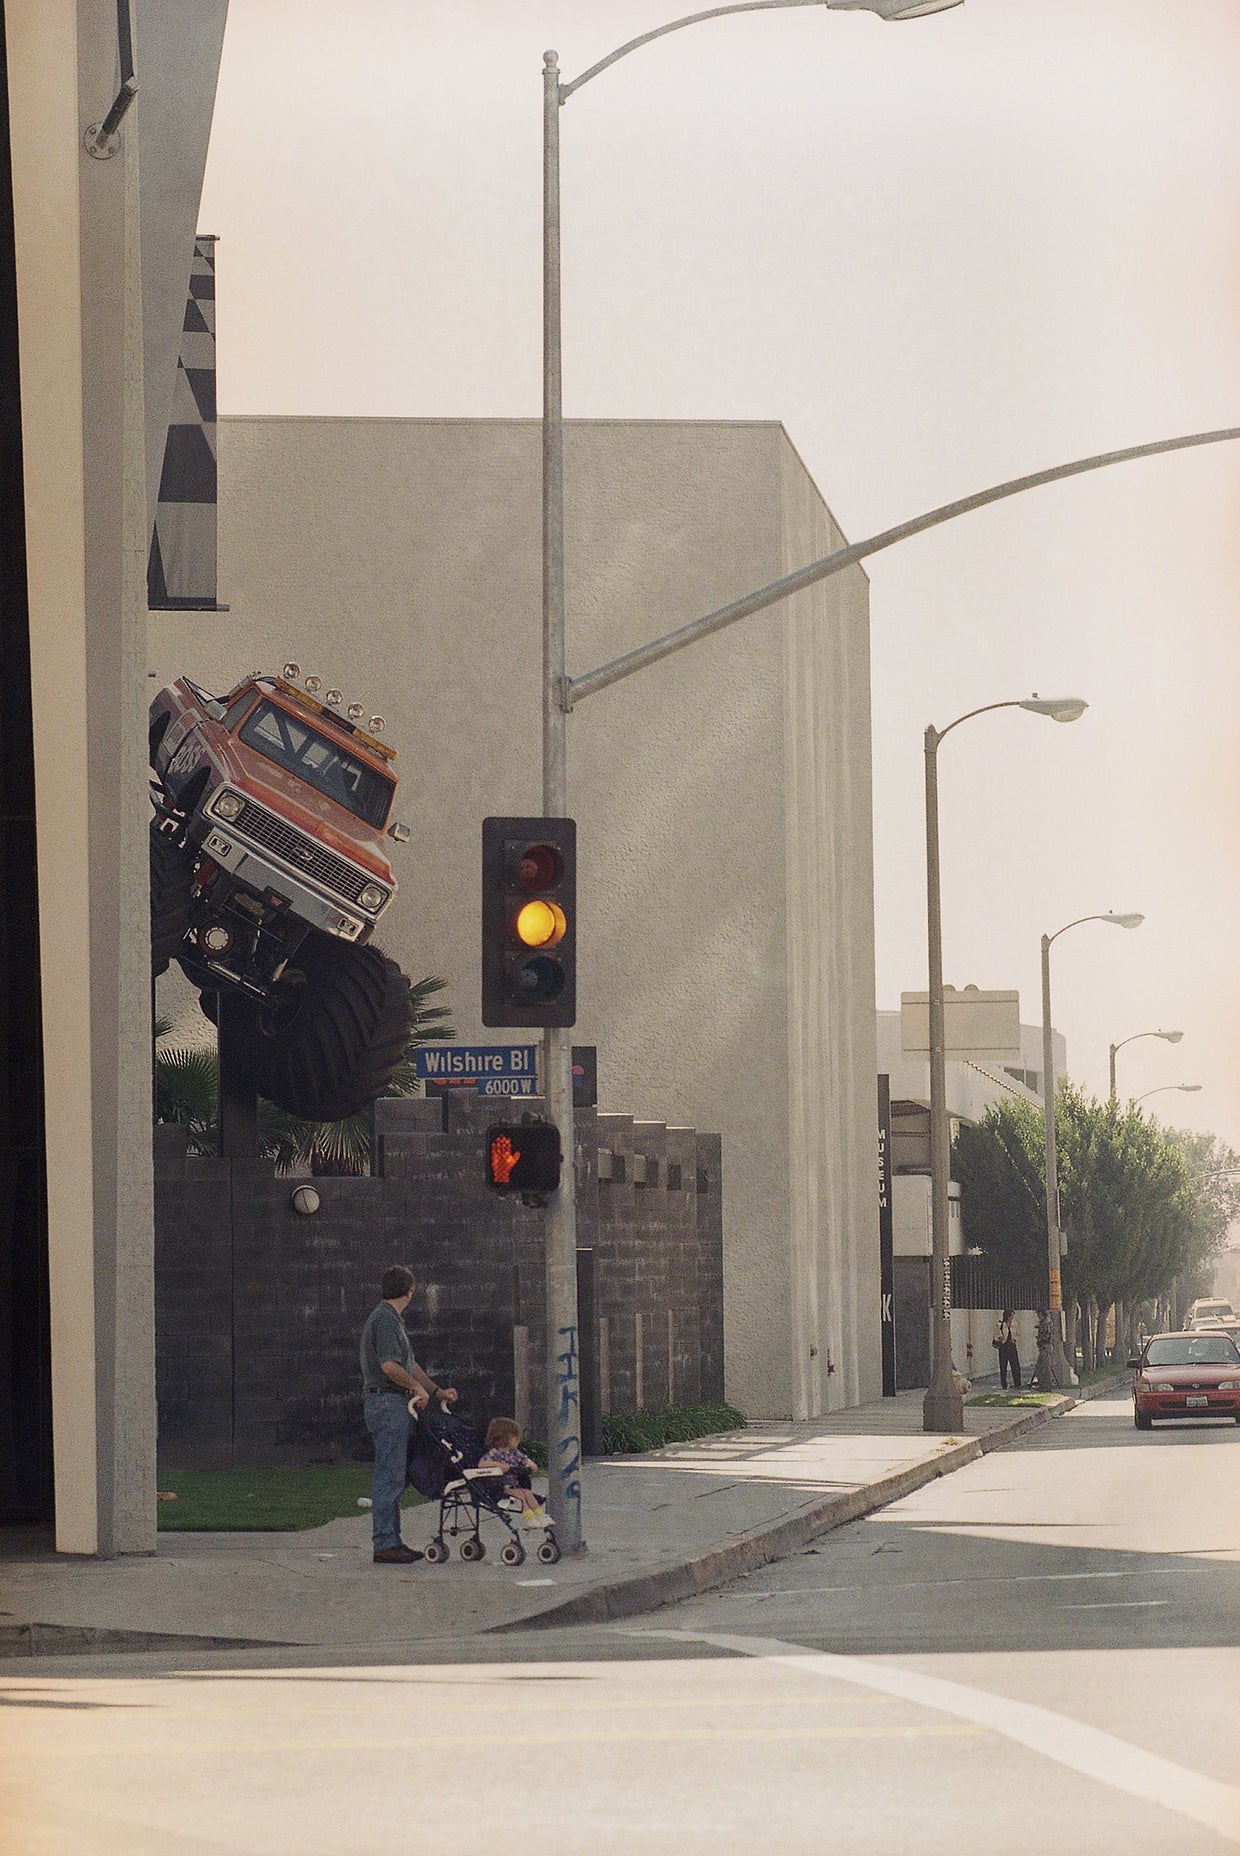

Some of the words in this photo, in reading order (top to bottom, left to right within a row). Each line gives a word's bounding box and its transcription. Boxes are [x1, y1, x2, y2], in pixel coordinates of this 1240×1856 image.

[424, 1051, 504, 1073] Wilshire
[510, 1050, 529, 1072] Bl
[485, 1079, 519, 1095] 6000
[521, 1079, 532, 1094] W
[877, 1129, 887, 1208] MUSEUM
